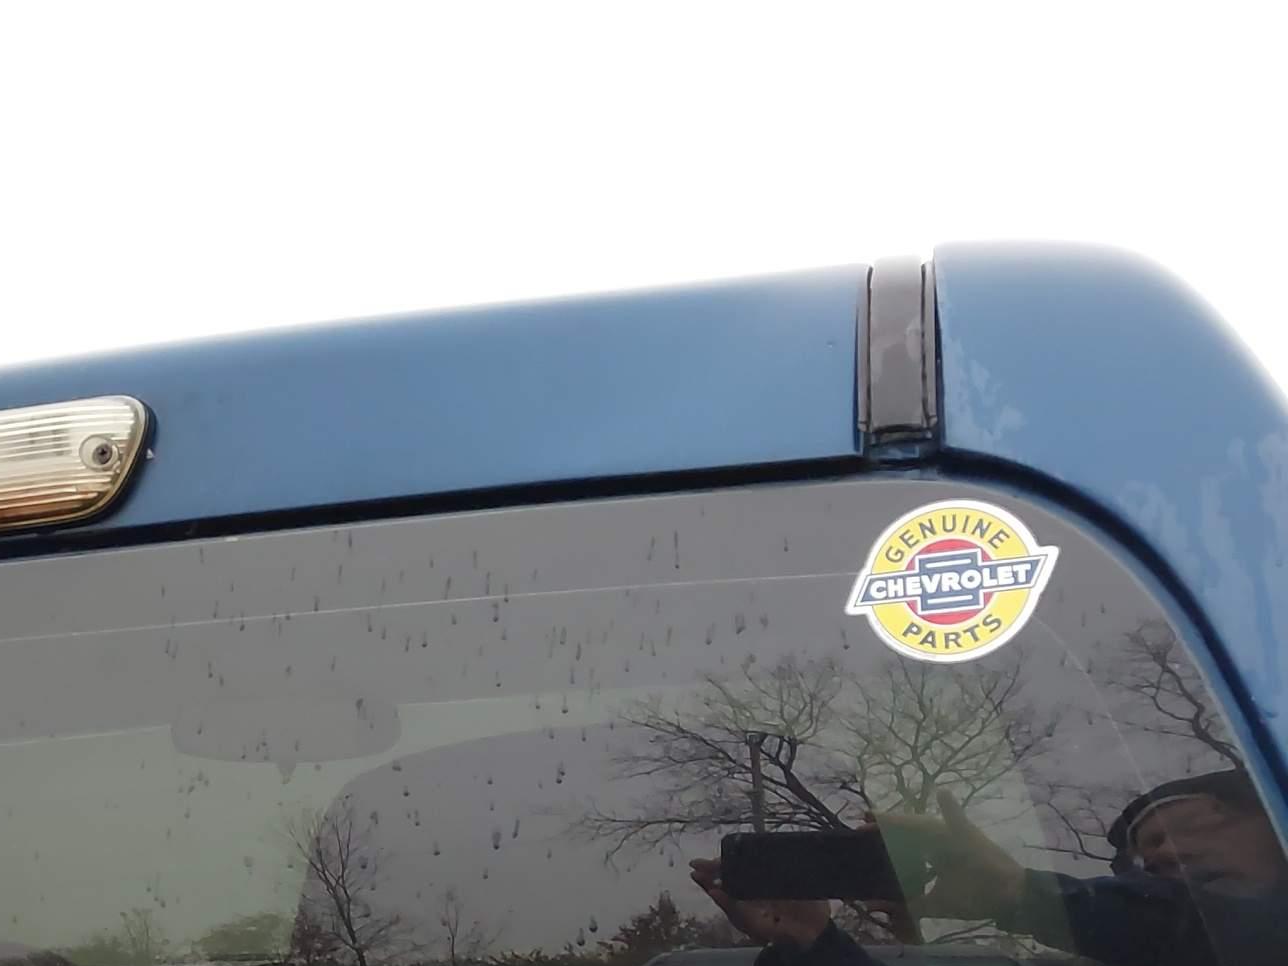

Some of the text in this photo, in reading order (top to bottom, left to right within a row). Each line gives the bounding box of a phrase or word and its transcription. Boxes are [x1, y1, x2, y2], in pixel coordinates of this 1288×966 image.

[885, 514, 1010, 563] GENUINE
[870, 563, 1031, 599] CHEVROLET
[902, 614, 1001, 649] PARTS
